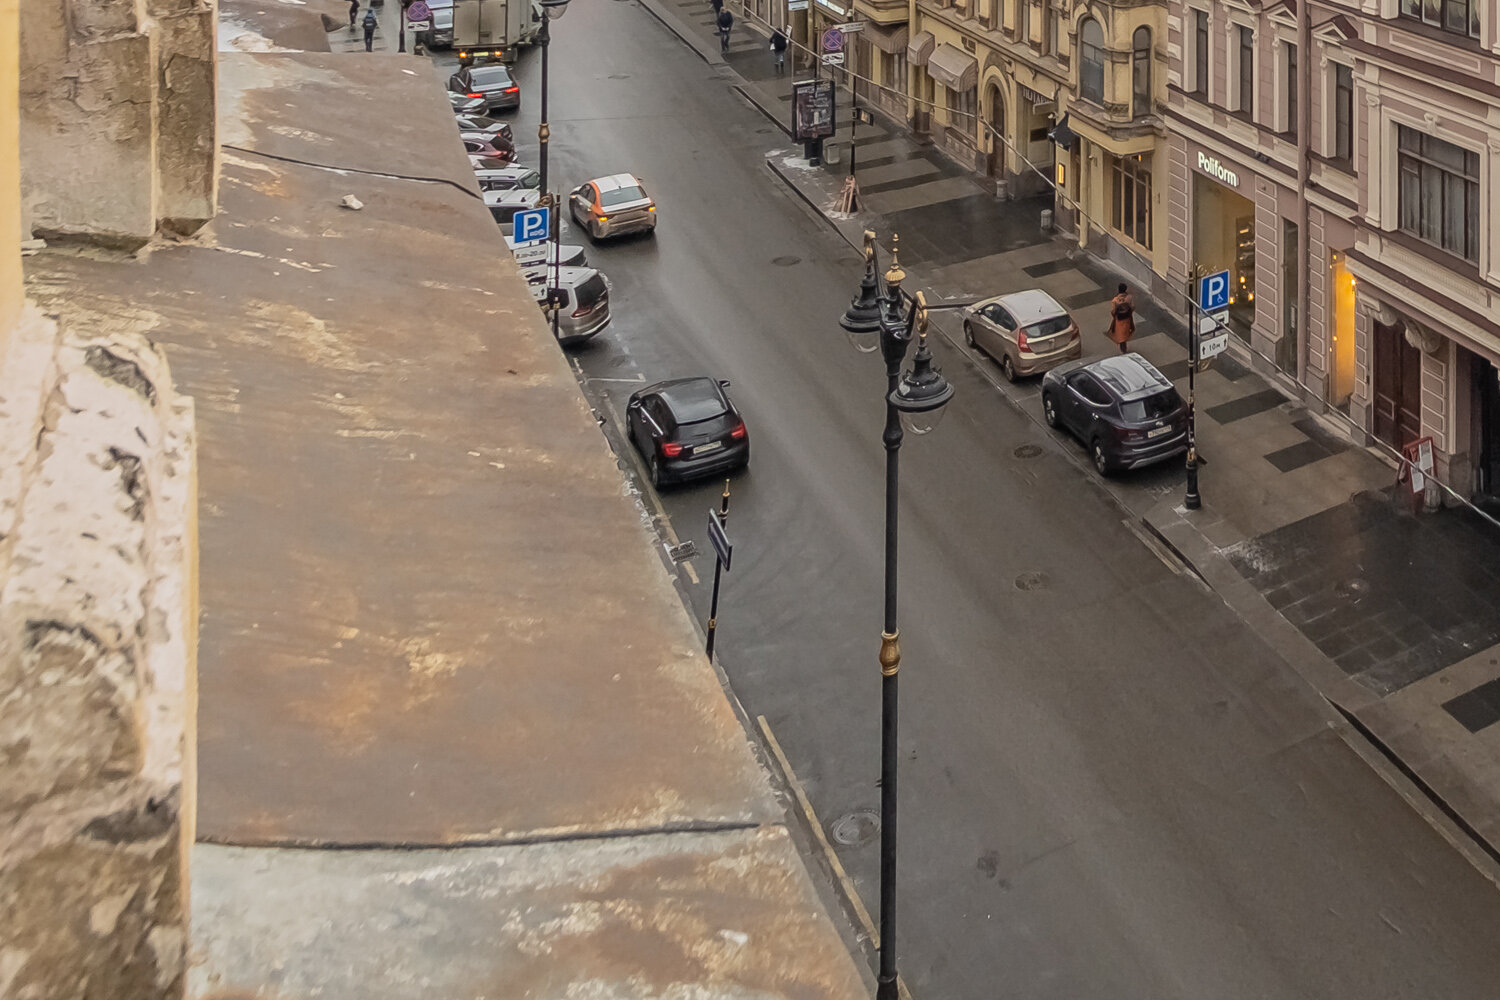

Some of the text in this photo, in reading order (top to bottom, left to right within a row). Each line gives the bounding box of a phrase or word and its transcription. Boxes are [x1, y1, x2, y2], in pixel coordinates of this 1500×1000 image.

[1197, 150, 1238, 188] Poliform
[523, 213, 542, 239] P
[1208, 276, 1225, 306] P
